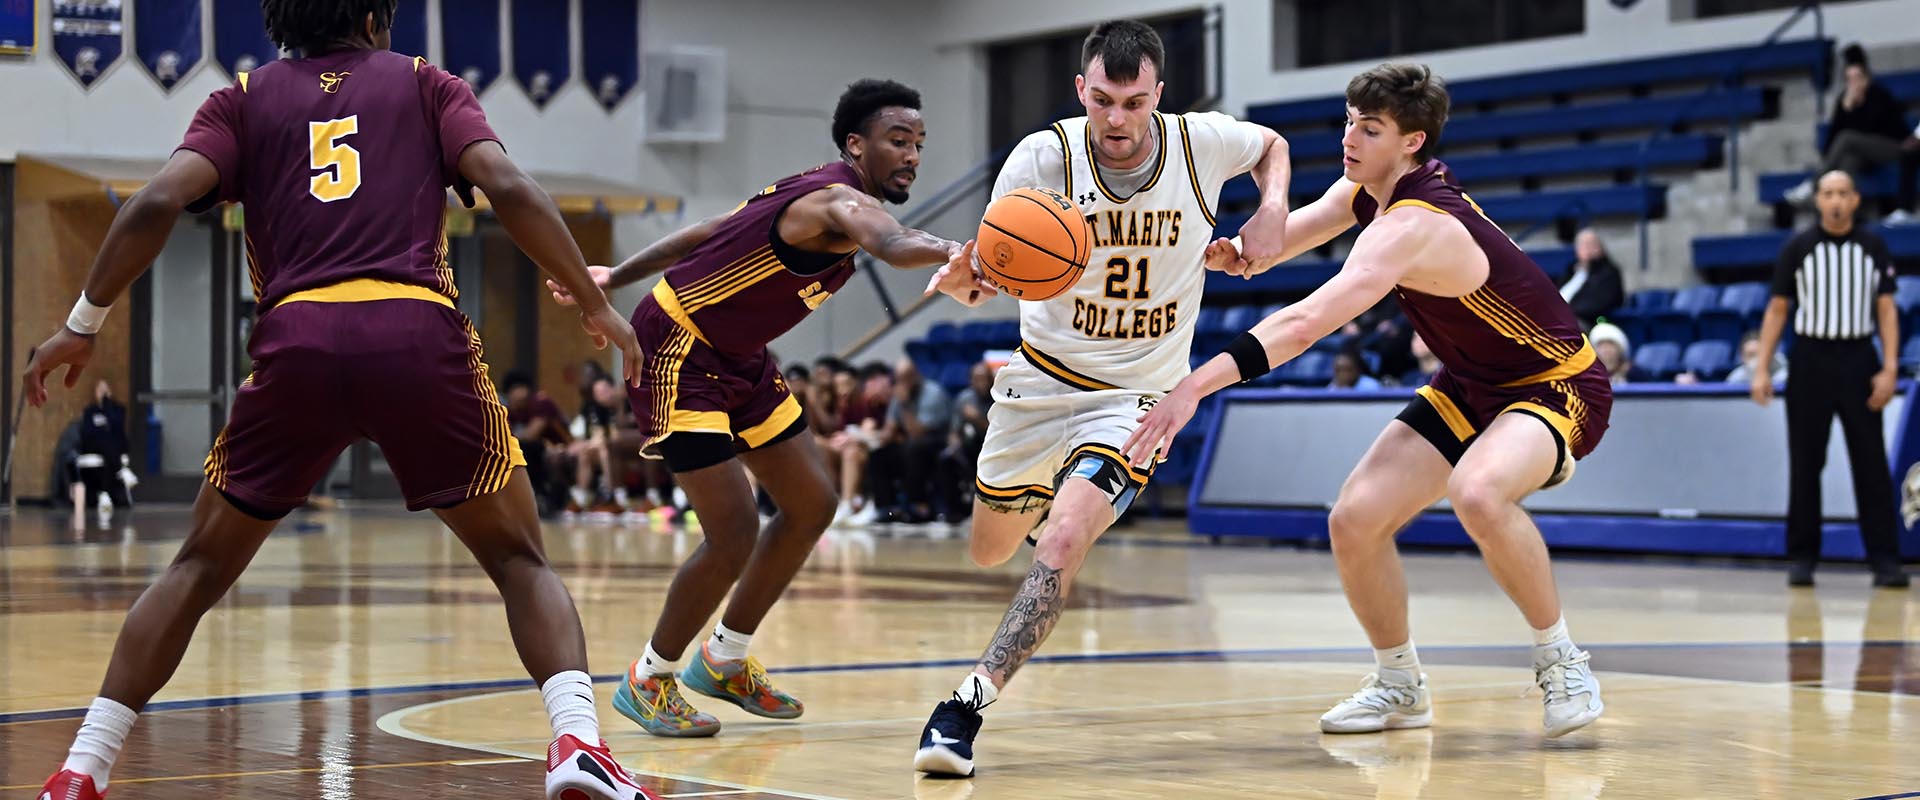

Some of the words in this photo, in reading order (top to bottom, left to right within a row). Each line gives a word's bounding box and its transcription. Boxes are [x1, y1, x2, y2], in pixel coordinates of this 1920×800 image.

[309, 114, 362, 203] 5
[1086, 210, 1182, 249] T.MARY'S
[797, 280, 833, 311] SA
[1103, 254, 1152, 300] 21
[1072, 296, 1178, 340] COLLEGE
